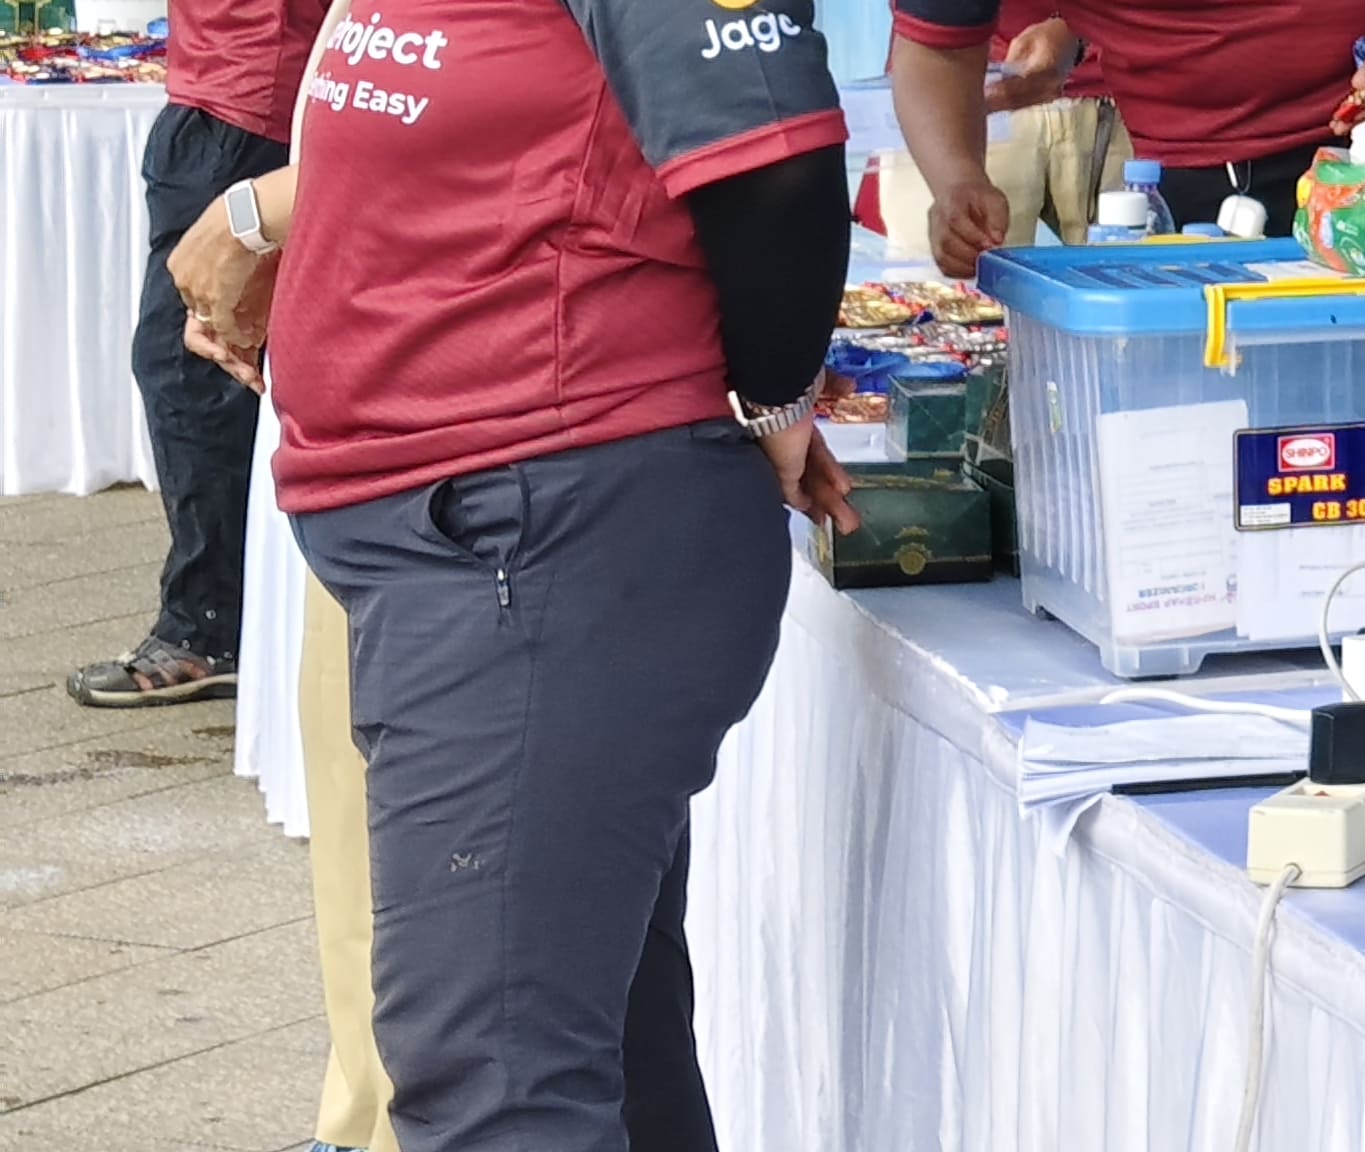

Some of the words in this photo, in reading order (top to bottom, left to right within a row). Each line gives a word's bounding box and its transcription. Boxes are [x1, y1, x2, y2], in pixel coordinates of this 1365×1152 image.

[353, 80, 429, 124] Easy
[1284, 445, 1329, 460] SHINPO
[1267, 473, 1347, 496] SPARK
